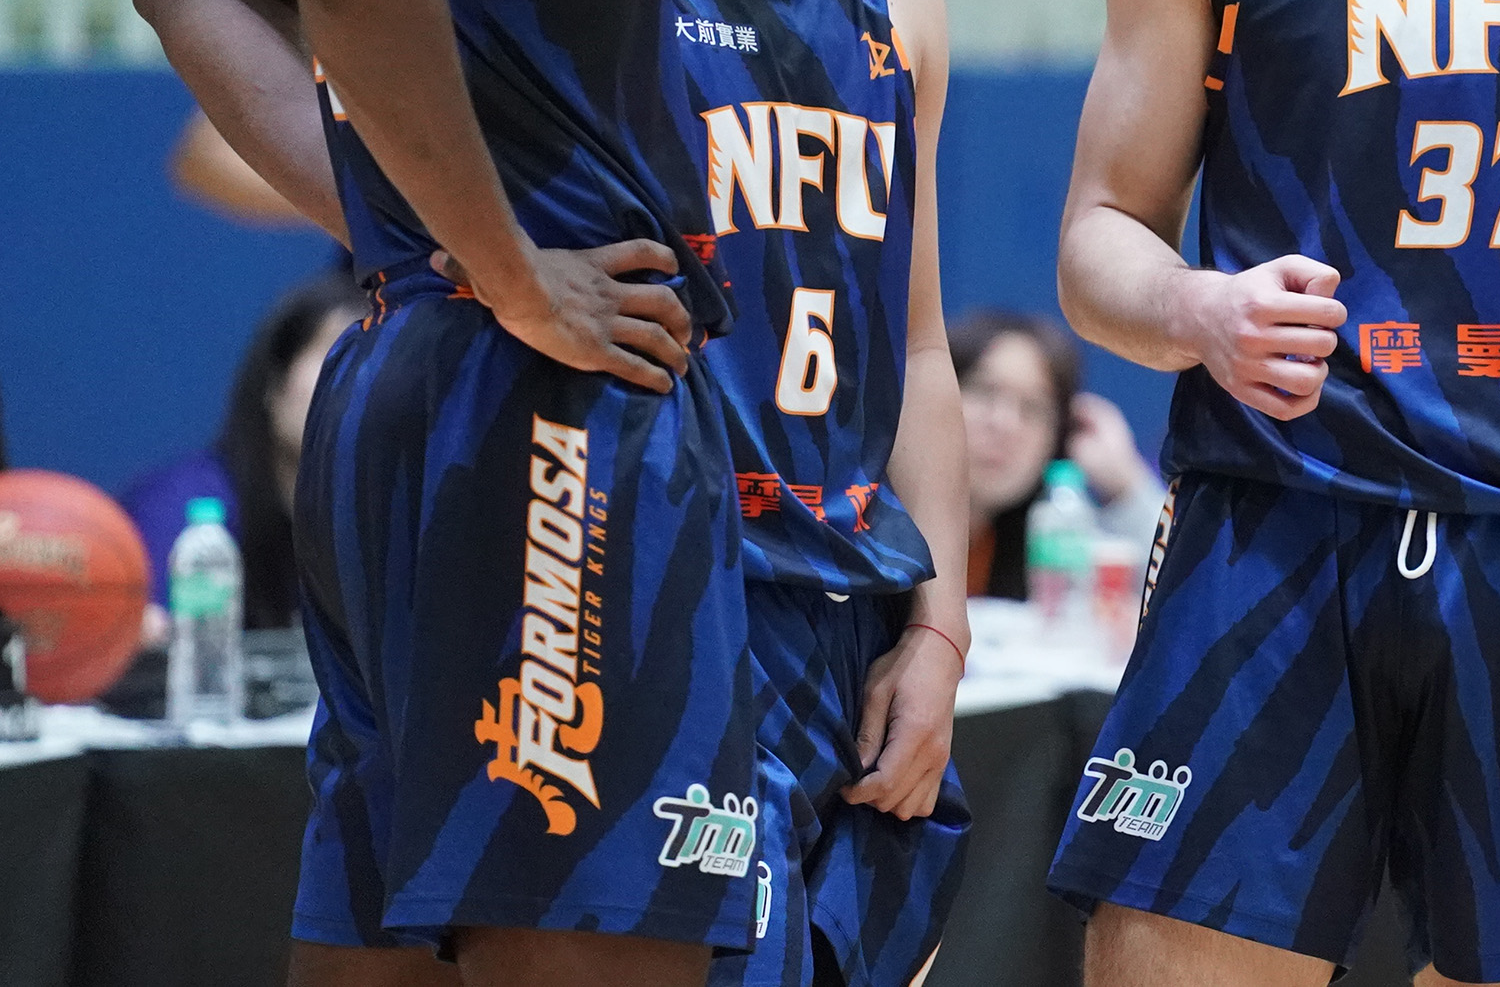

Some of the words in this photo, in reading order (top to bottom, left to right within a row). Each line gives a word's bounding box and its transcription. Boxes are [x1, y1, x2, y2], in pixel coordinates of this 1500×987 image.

[674, 16, 759, 53] 大前實業
[774, 286, 839, 417] 6
[586, 486, 610, 576] KINGS
[516, 411, 602, 811] FORMOSA
[583, 589, 604, 676] TIGER
